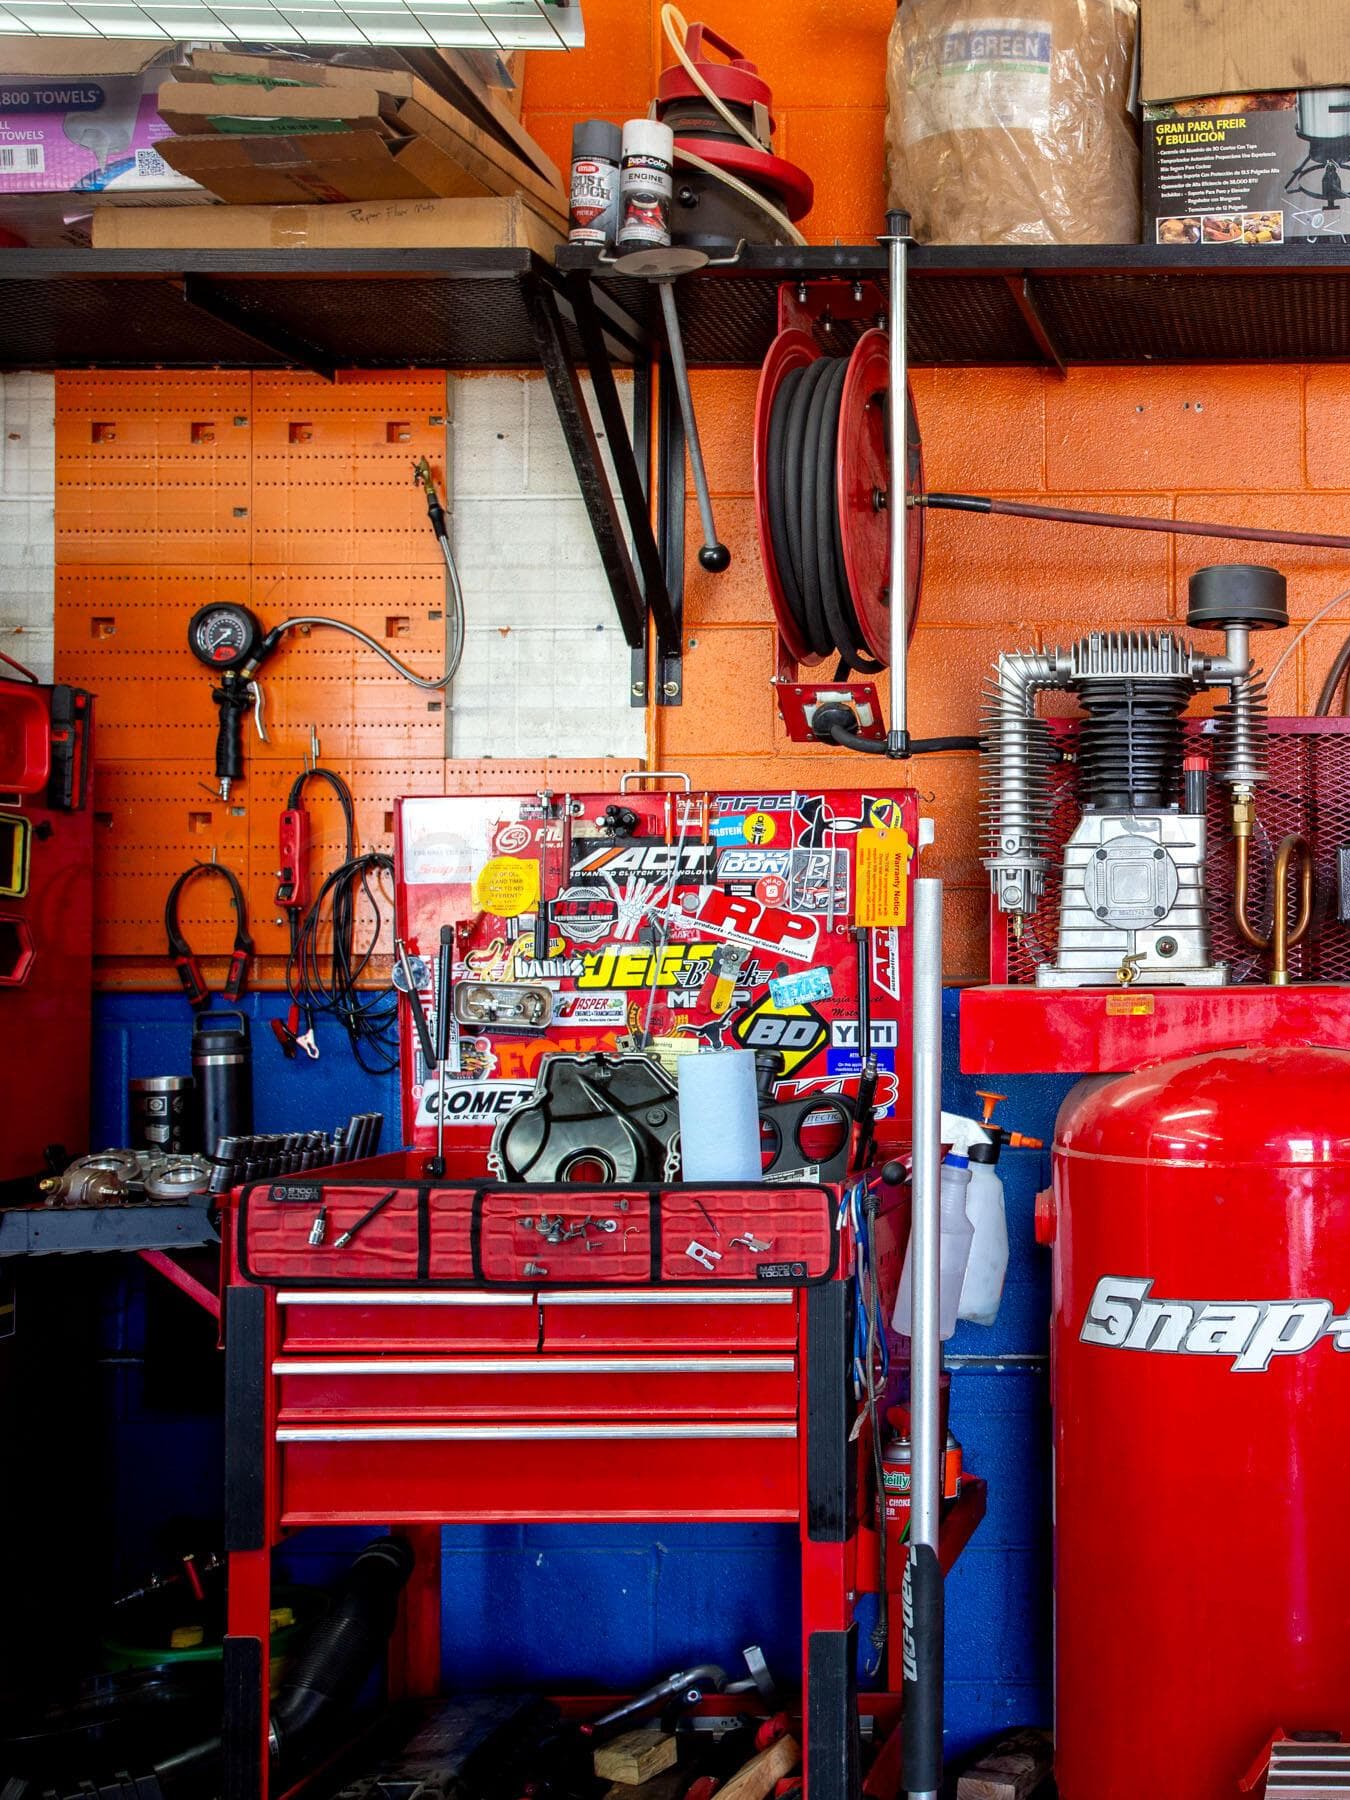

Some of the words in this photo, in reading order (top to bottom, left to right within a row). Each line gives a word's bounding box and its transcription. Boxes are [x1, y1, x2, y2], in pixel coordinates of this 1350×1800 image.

[971, 36, 1039, 57] GREEN
[2, 131, 45, 141] TOWELS
[1156, 122, 1185, 134] GRAN
[1188, 120, 1214, 132] PARA
[1217, 118, 1247, 130] FREIR
[1156, 135, 1164, 146] Y
[628, 172, 664, 184] ENGINE
[590, 846, 714, 871] ACT
[892, 852, 902, 888] Warranty
[893, 890, 902, 916] Notice
[693, 920, 724, 933] products
[761, 941, 780, 952] Quality
[514, 956, 584, 978] banks
[875, 926, 890, 990] AR
[560, 996, 608, 1018] JASPER
[747, 1018, 820, 1047] BD
[425, 1090, 535, 1114] COMET
